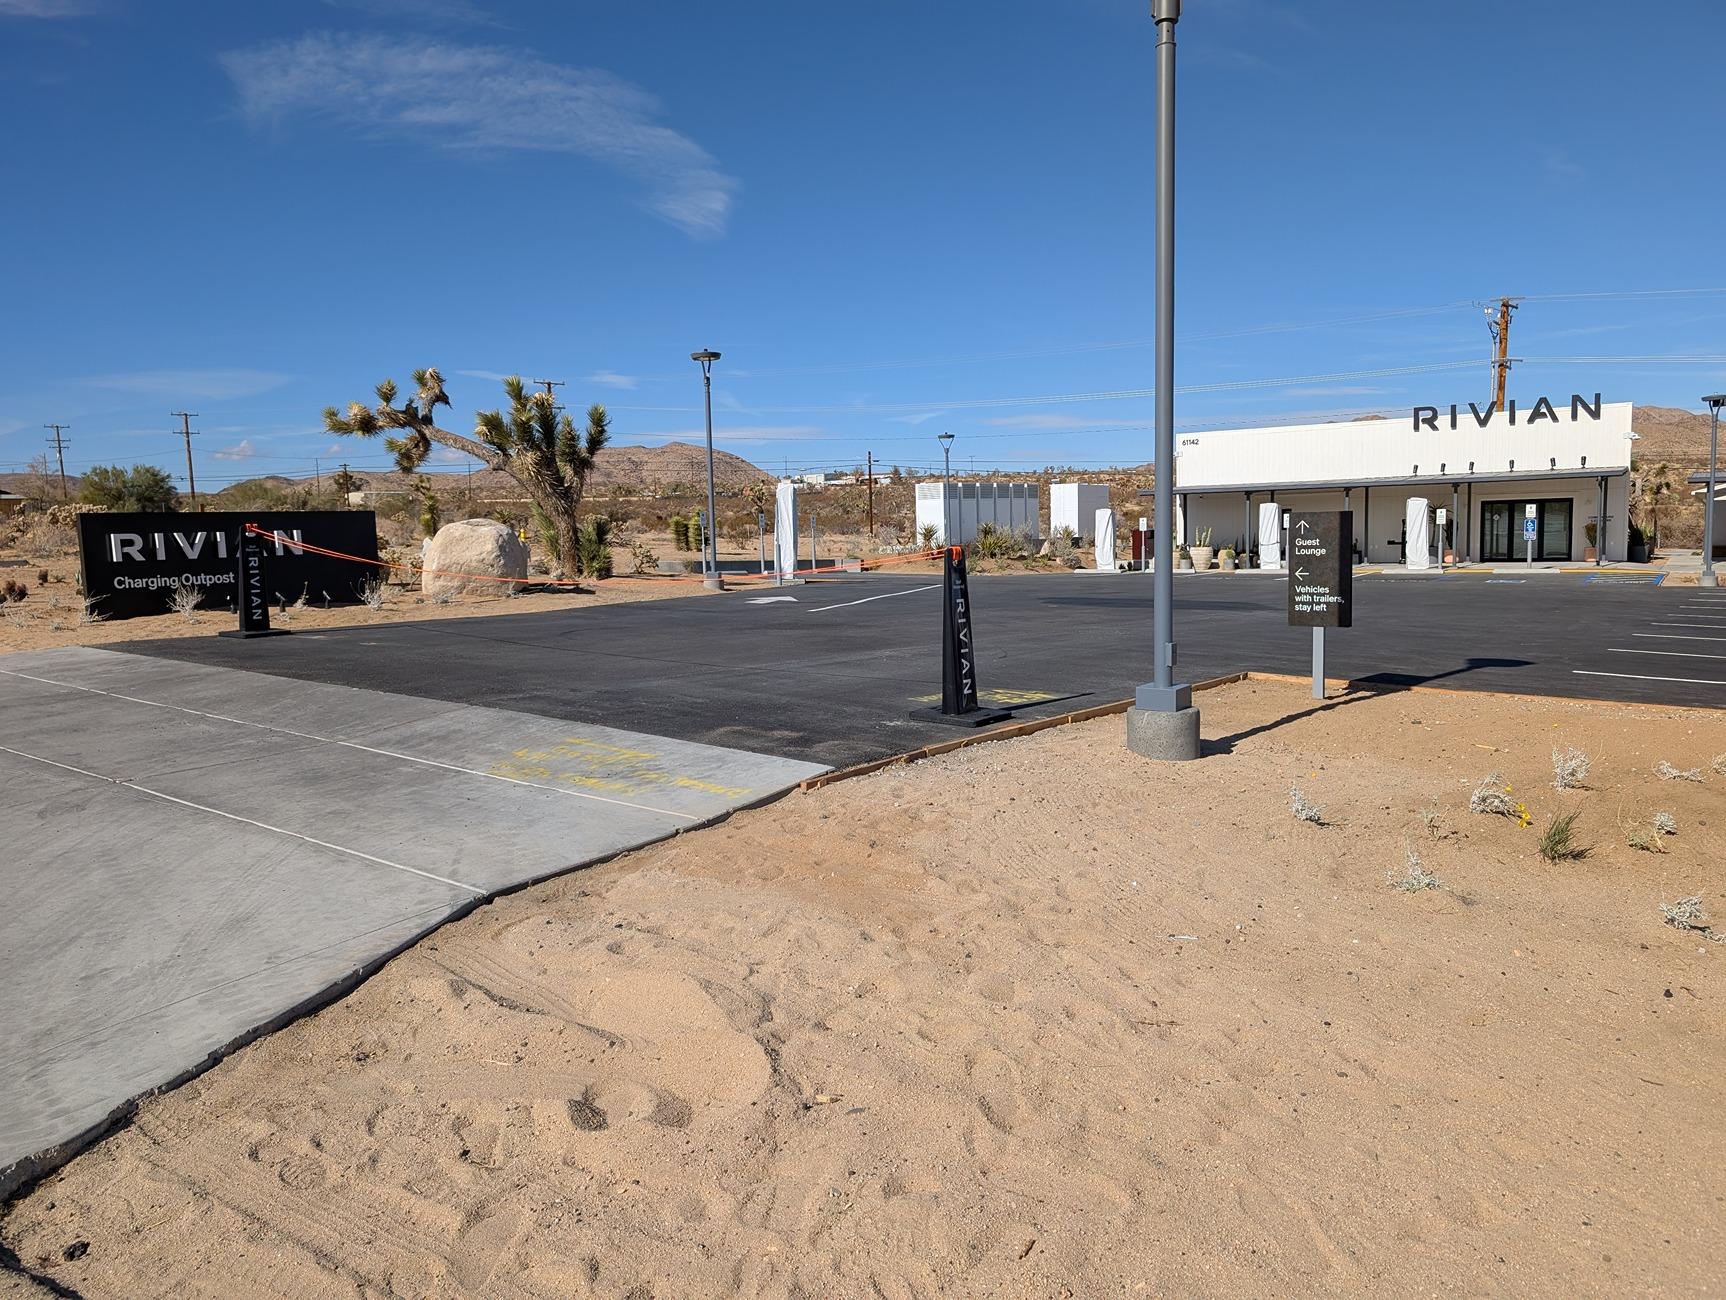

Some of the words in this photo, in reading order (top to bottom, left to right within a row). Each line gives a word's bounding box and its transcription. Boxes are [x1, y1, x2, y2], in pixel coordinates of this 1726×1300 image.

[1413, 393, 1601, 432] RIVIAN
[1182, 438, 1200, 446] 61142
[1295, 538, 1320, 546] Guest
[1295, 547, 1326, 556] Lounge
[114, 575, 179, 590] Charging
[181, 571, 235, 587] Outpost
[248, 557, 263, 620] RIVIAN
[1295, 585, 1329, 593] Vehicles
[1313, 595, 1344, 604] trailers,
[1295, 604, 1312, 612] stay
[1313, 603, 1326, 611] left
[956, 599, 972, 694] RIVIAN
